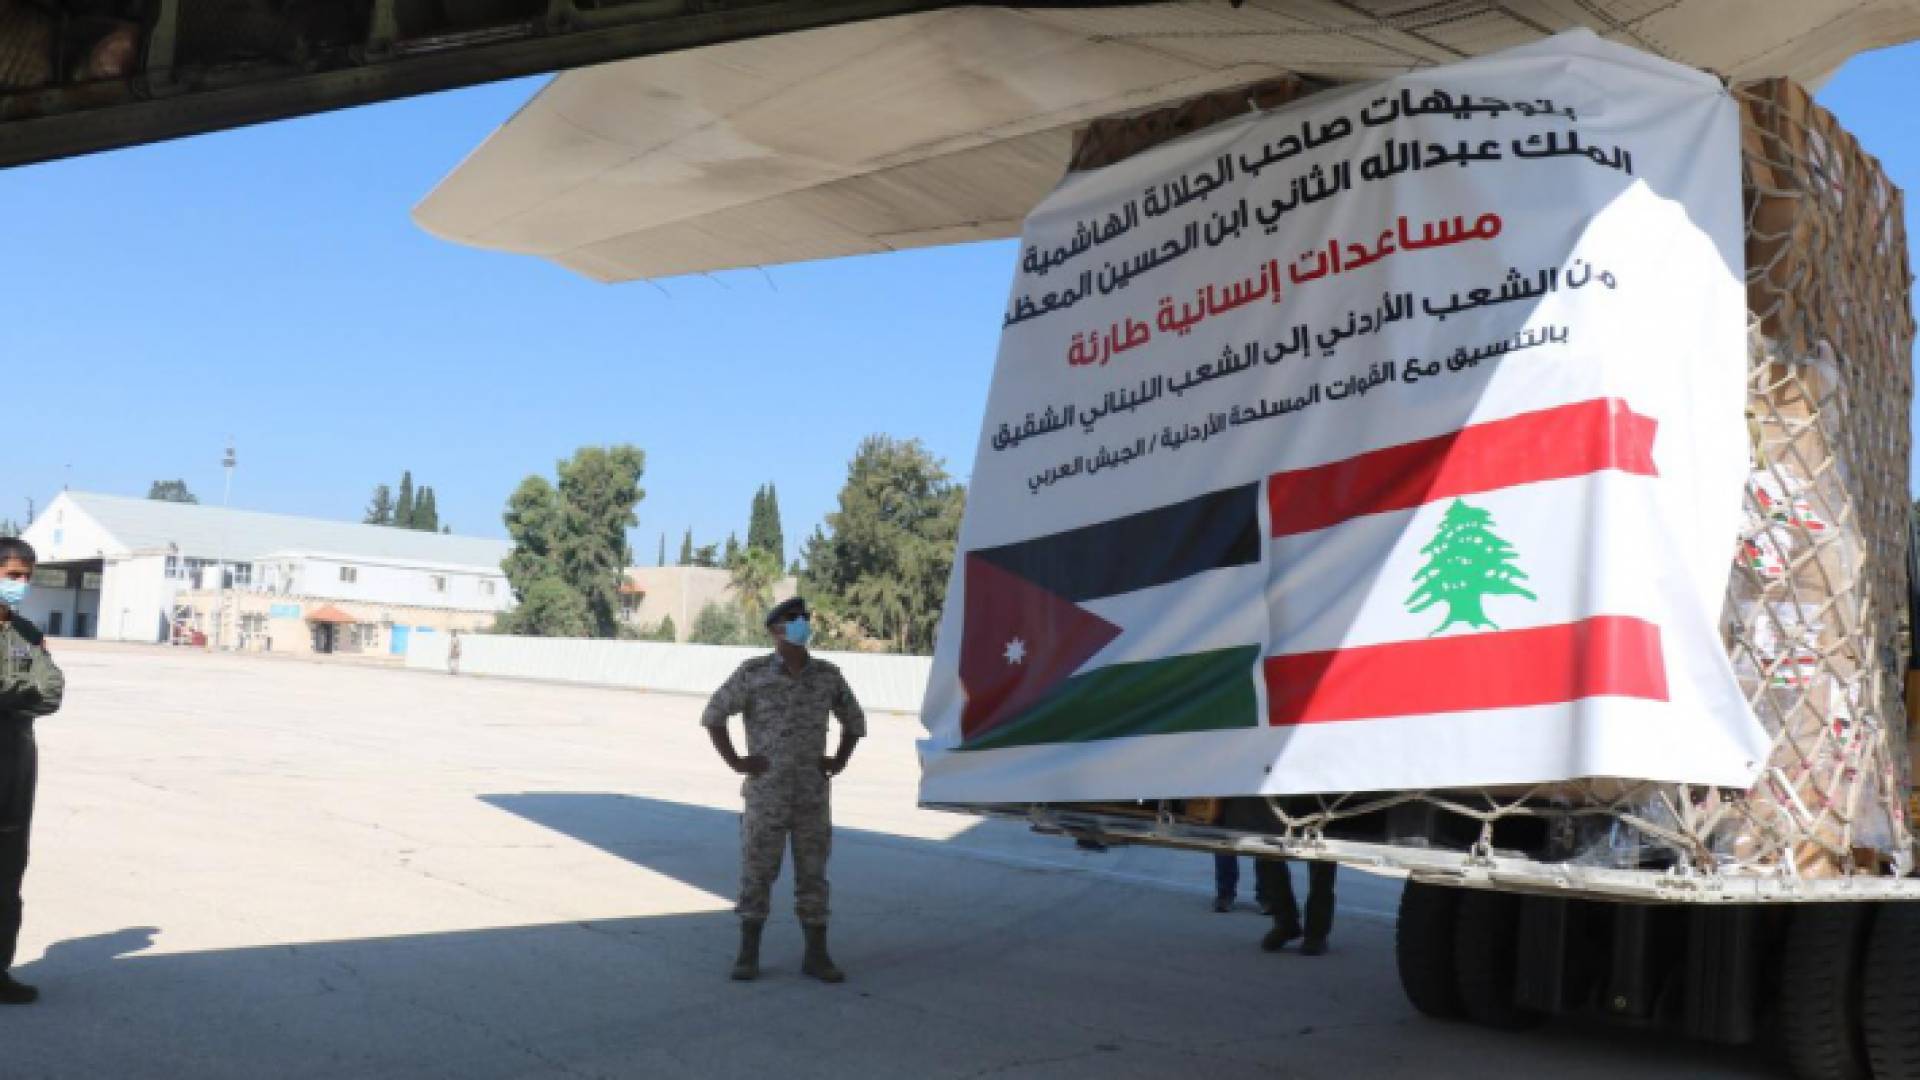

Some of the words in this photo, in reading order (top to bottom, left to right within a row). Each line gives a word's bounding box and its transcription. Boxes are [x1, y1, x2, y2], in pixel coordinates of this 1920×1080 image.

[1239, 116, 1352, 176] صاحب
[1361, 138, 1503, 182] عبدالله
[1512, 131, 1632, 175] الملك
[1143, 153, 1235, 219] الجلالة
[1255, 160, 1351, 234] الثاني
[1023, 200, 1138, 275] الهاشمية
[1205, 199, 1248, 247] ابن
[1098, 221, 1198, 295] الحسين
[1288, 212, 1503, 284] مساعدات
[1156, 259, 1281, 337] إنسانية
[1422, 266, 1559, 322] الشعب
[1566, 258, 1617, 290] من
[1068, 318, 1151, 367] طارئة
[1263, 323, 1310, 366] إلى
[1316, 290, 1413, 357] الأردني
[1167, 344, 1259, 397] الشعب
[1402, 358, 1441, 384] مع
[1446, 325, 1569, 373] بالتنسيق
[1079, 374, 1162, 435] اللبناني
[1229, 382, 1321, 426] المسلحة
[1325, 360, 1396, 401] القوات
[991, 404, 1075, 451] الشقيق
[1161, 411, 1226, 451] الأردنية
[1028, 455, 1083, 495] العربي
[1086, 436, 1146, 475] الجيش
